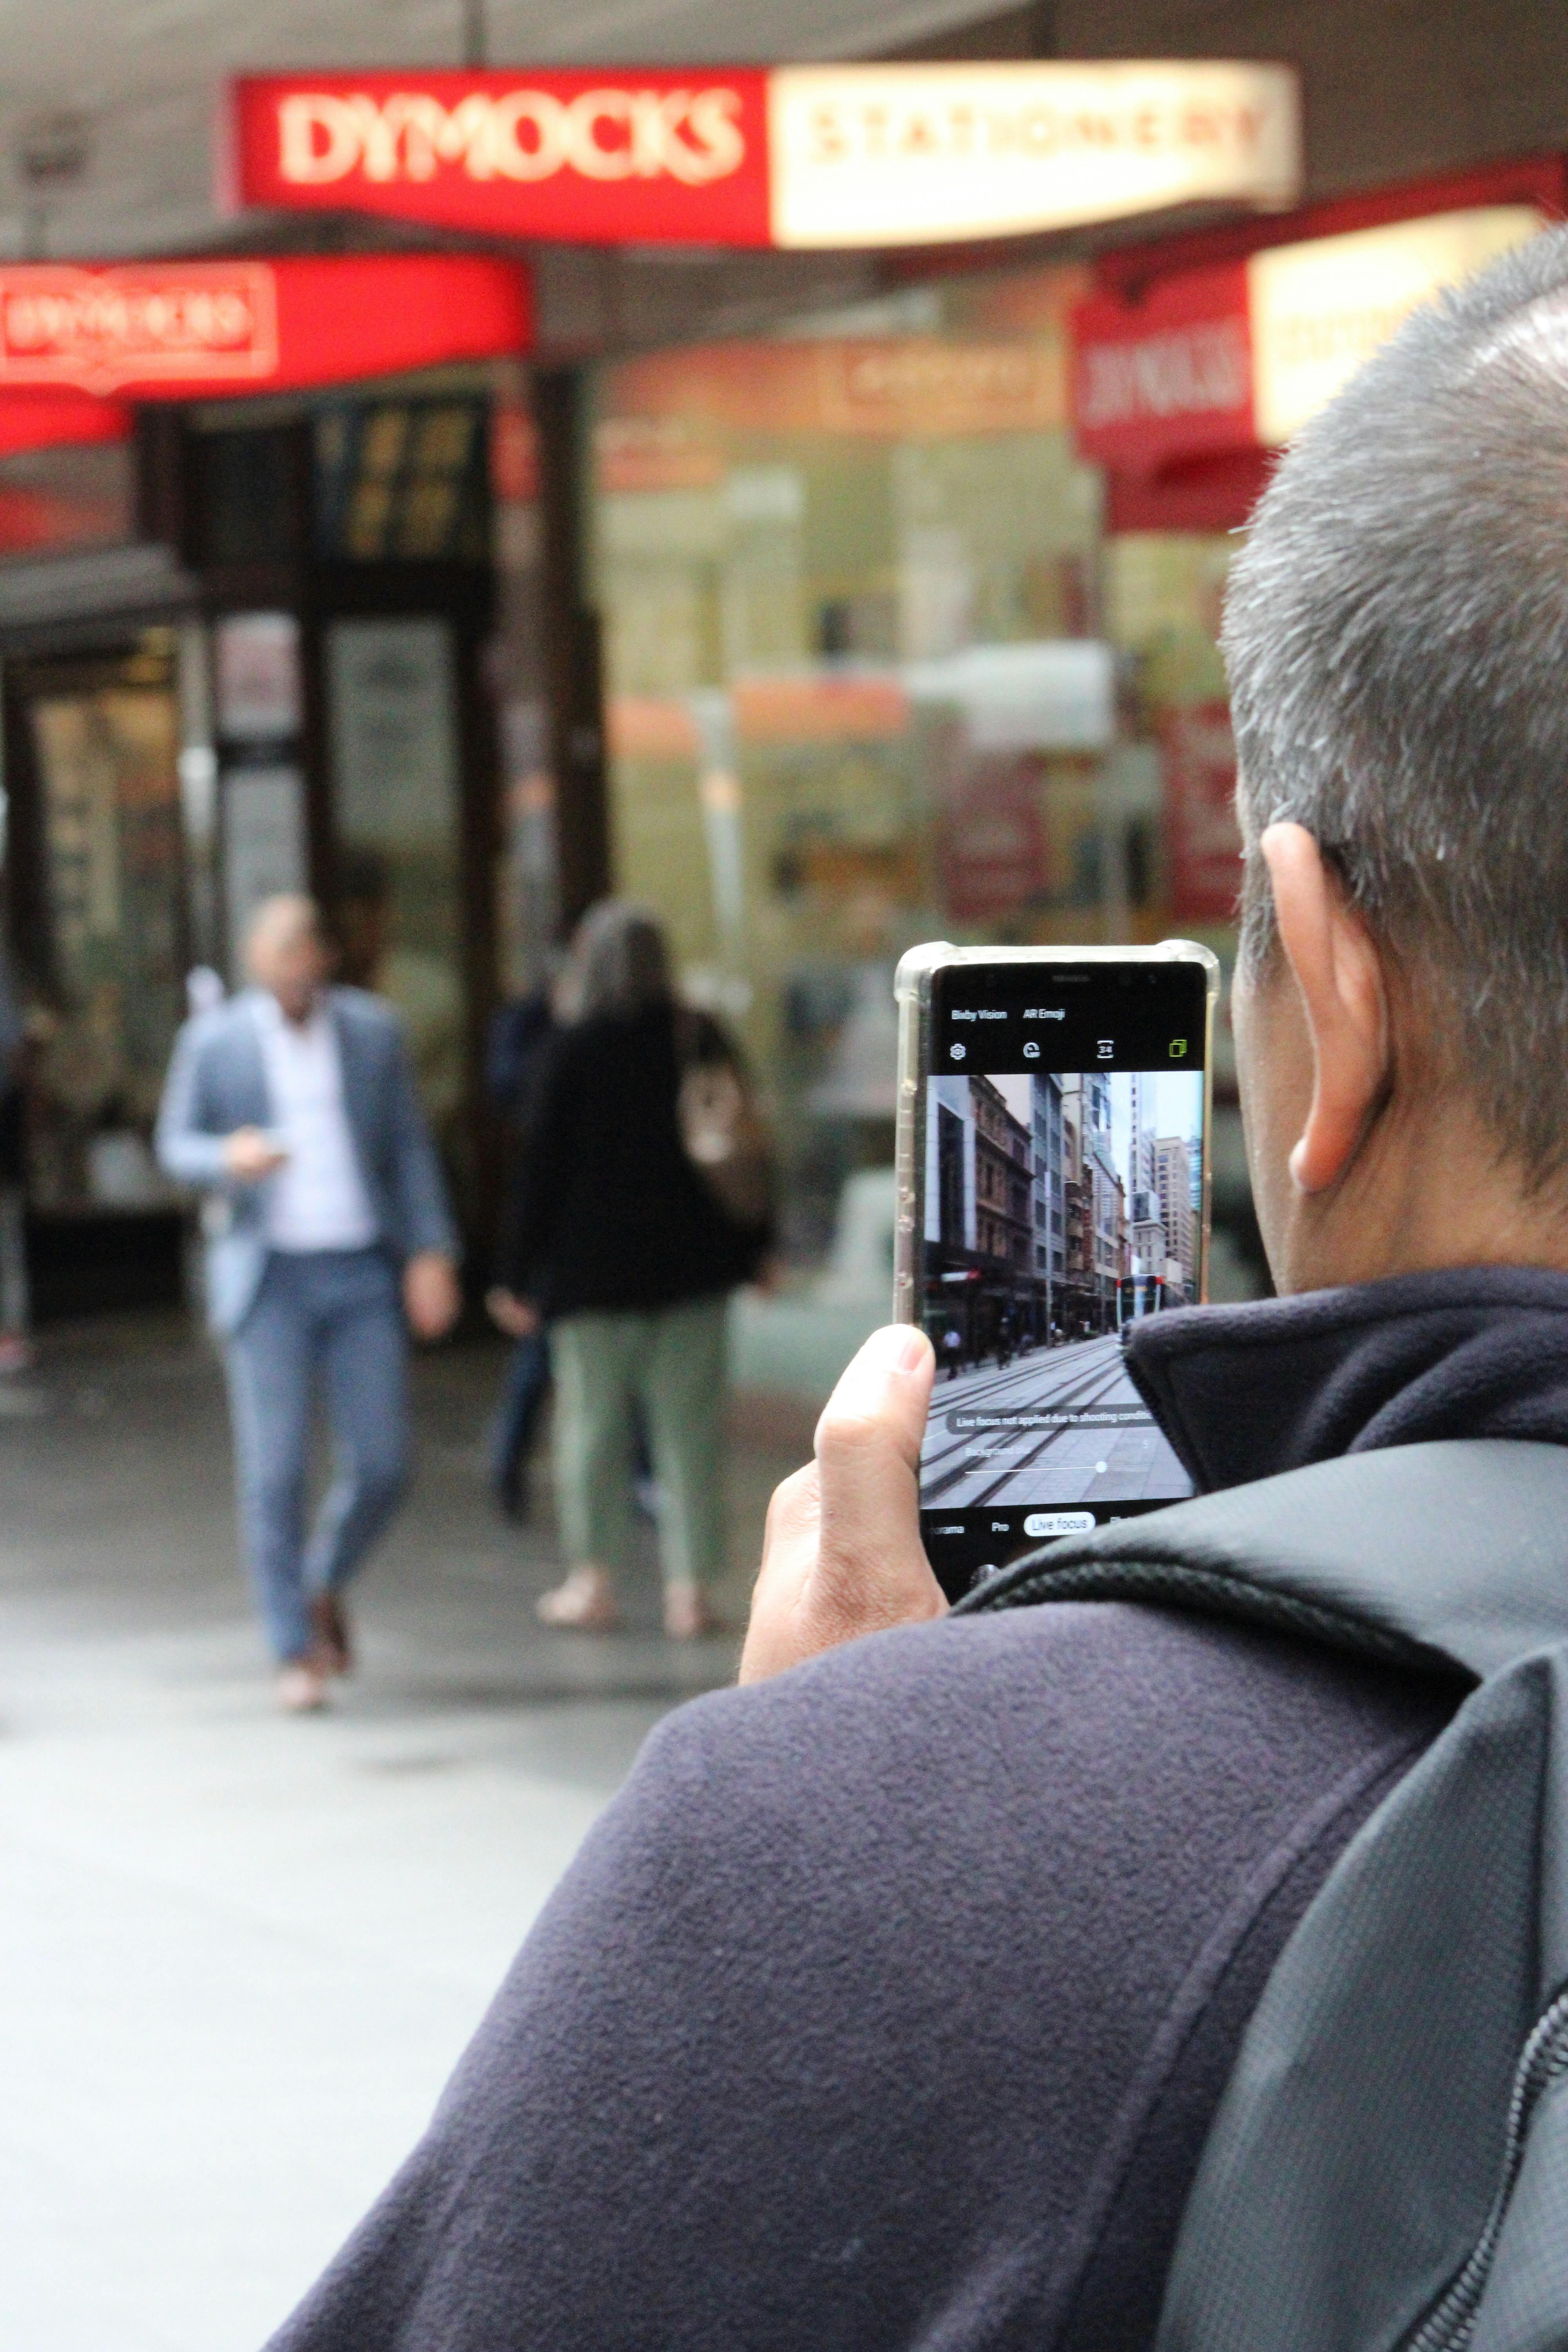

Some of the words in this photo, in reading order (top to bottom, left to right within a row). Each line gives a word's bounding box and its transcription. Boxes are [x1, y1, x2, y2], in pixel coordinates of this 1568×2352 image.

[279, 88, 745, 186] DYMOCKS
[809, 100, 1272, 162] STATIONERY
[952, 1010, 978, 1021] Bixby
[978, 1010, 1007, 1019] Vision
[1023, 1009, 1038, 1018] AR
[1039, 1009, 1065, 1020] Emoji
[956, 1418, 975, 1426] Live
[976, 1417, 1001, 1426] focus
[1002, 1416, 1017, 1425] not
[1018, 1414, 1051, 1426] applied
[1051, 1414, 1069, 1423] due
[1069, 1414, 1079, 1422] to
[1079, 1412, 1117, 1423] shooting
[965, 1447, 1014, 1457] Background
[992, 1522, 1009, 1532] Pro
[1031, 1519, 1054, 1530] Live
[1057, 1517, 1088, 1529] focus
